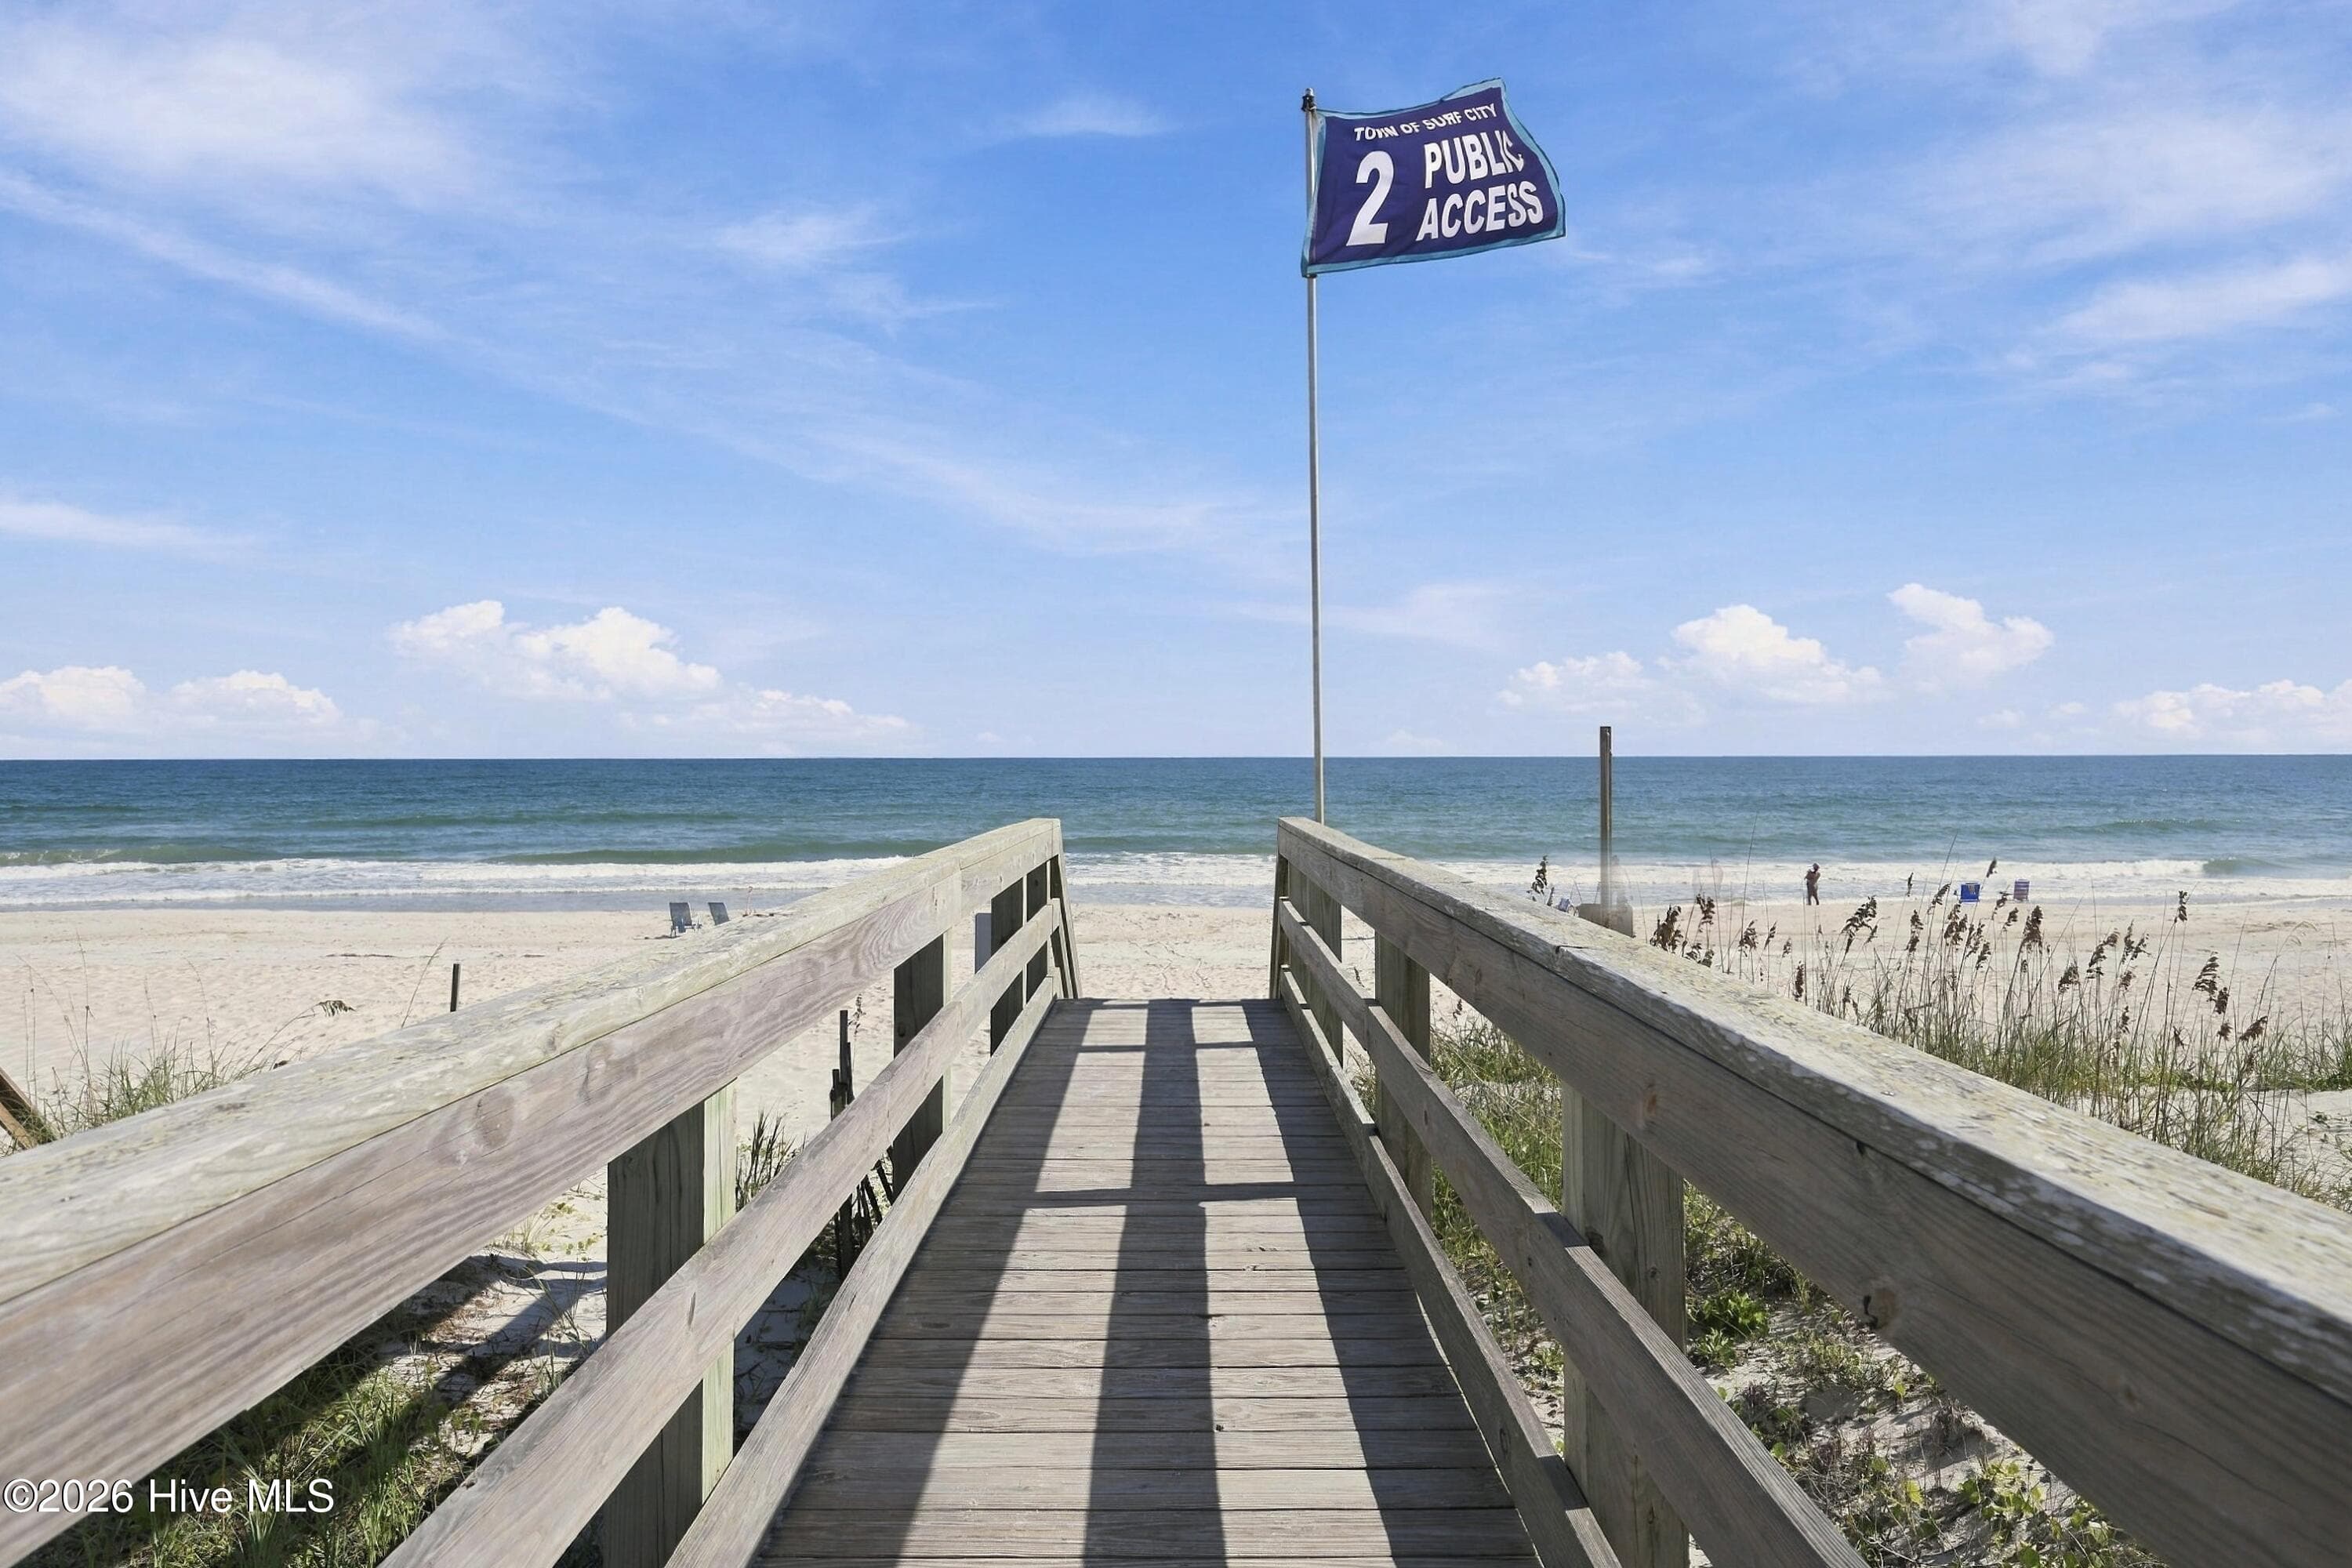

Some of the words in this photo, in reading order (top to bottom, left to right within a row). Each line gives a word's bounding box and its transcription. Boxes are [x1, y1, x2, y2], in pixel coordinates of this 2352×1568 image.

[1399, 122, 1420, 134] OF
[1422, 111, 1462, 130] SURF
[1464, 103, 1497, 122] CITY
[1346, 151, 1395, 246] 2
[1415, 180, 1544, 241] ACCESS
